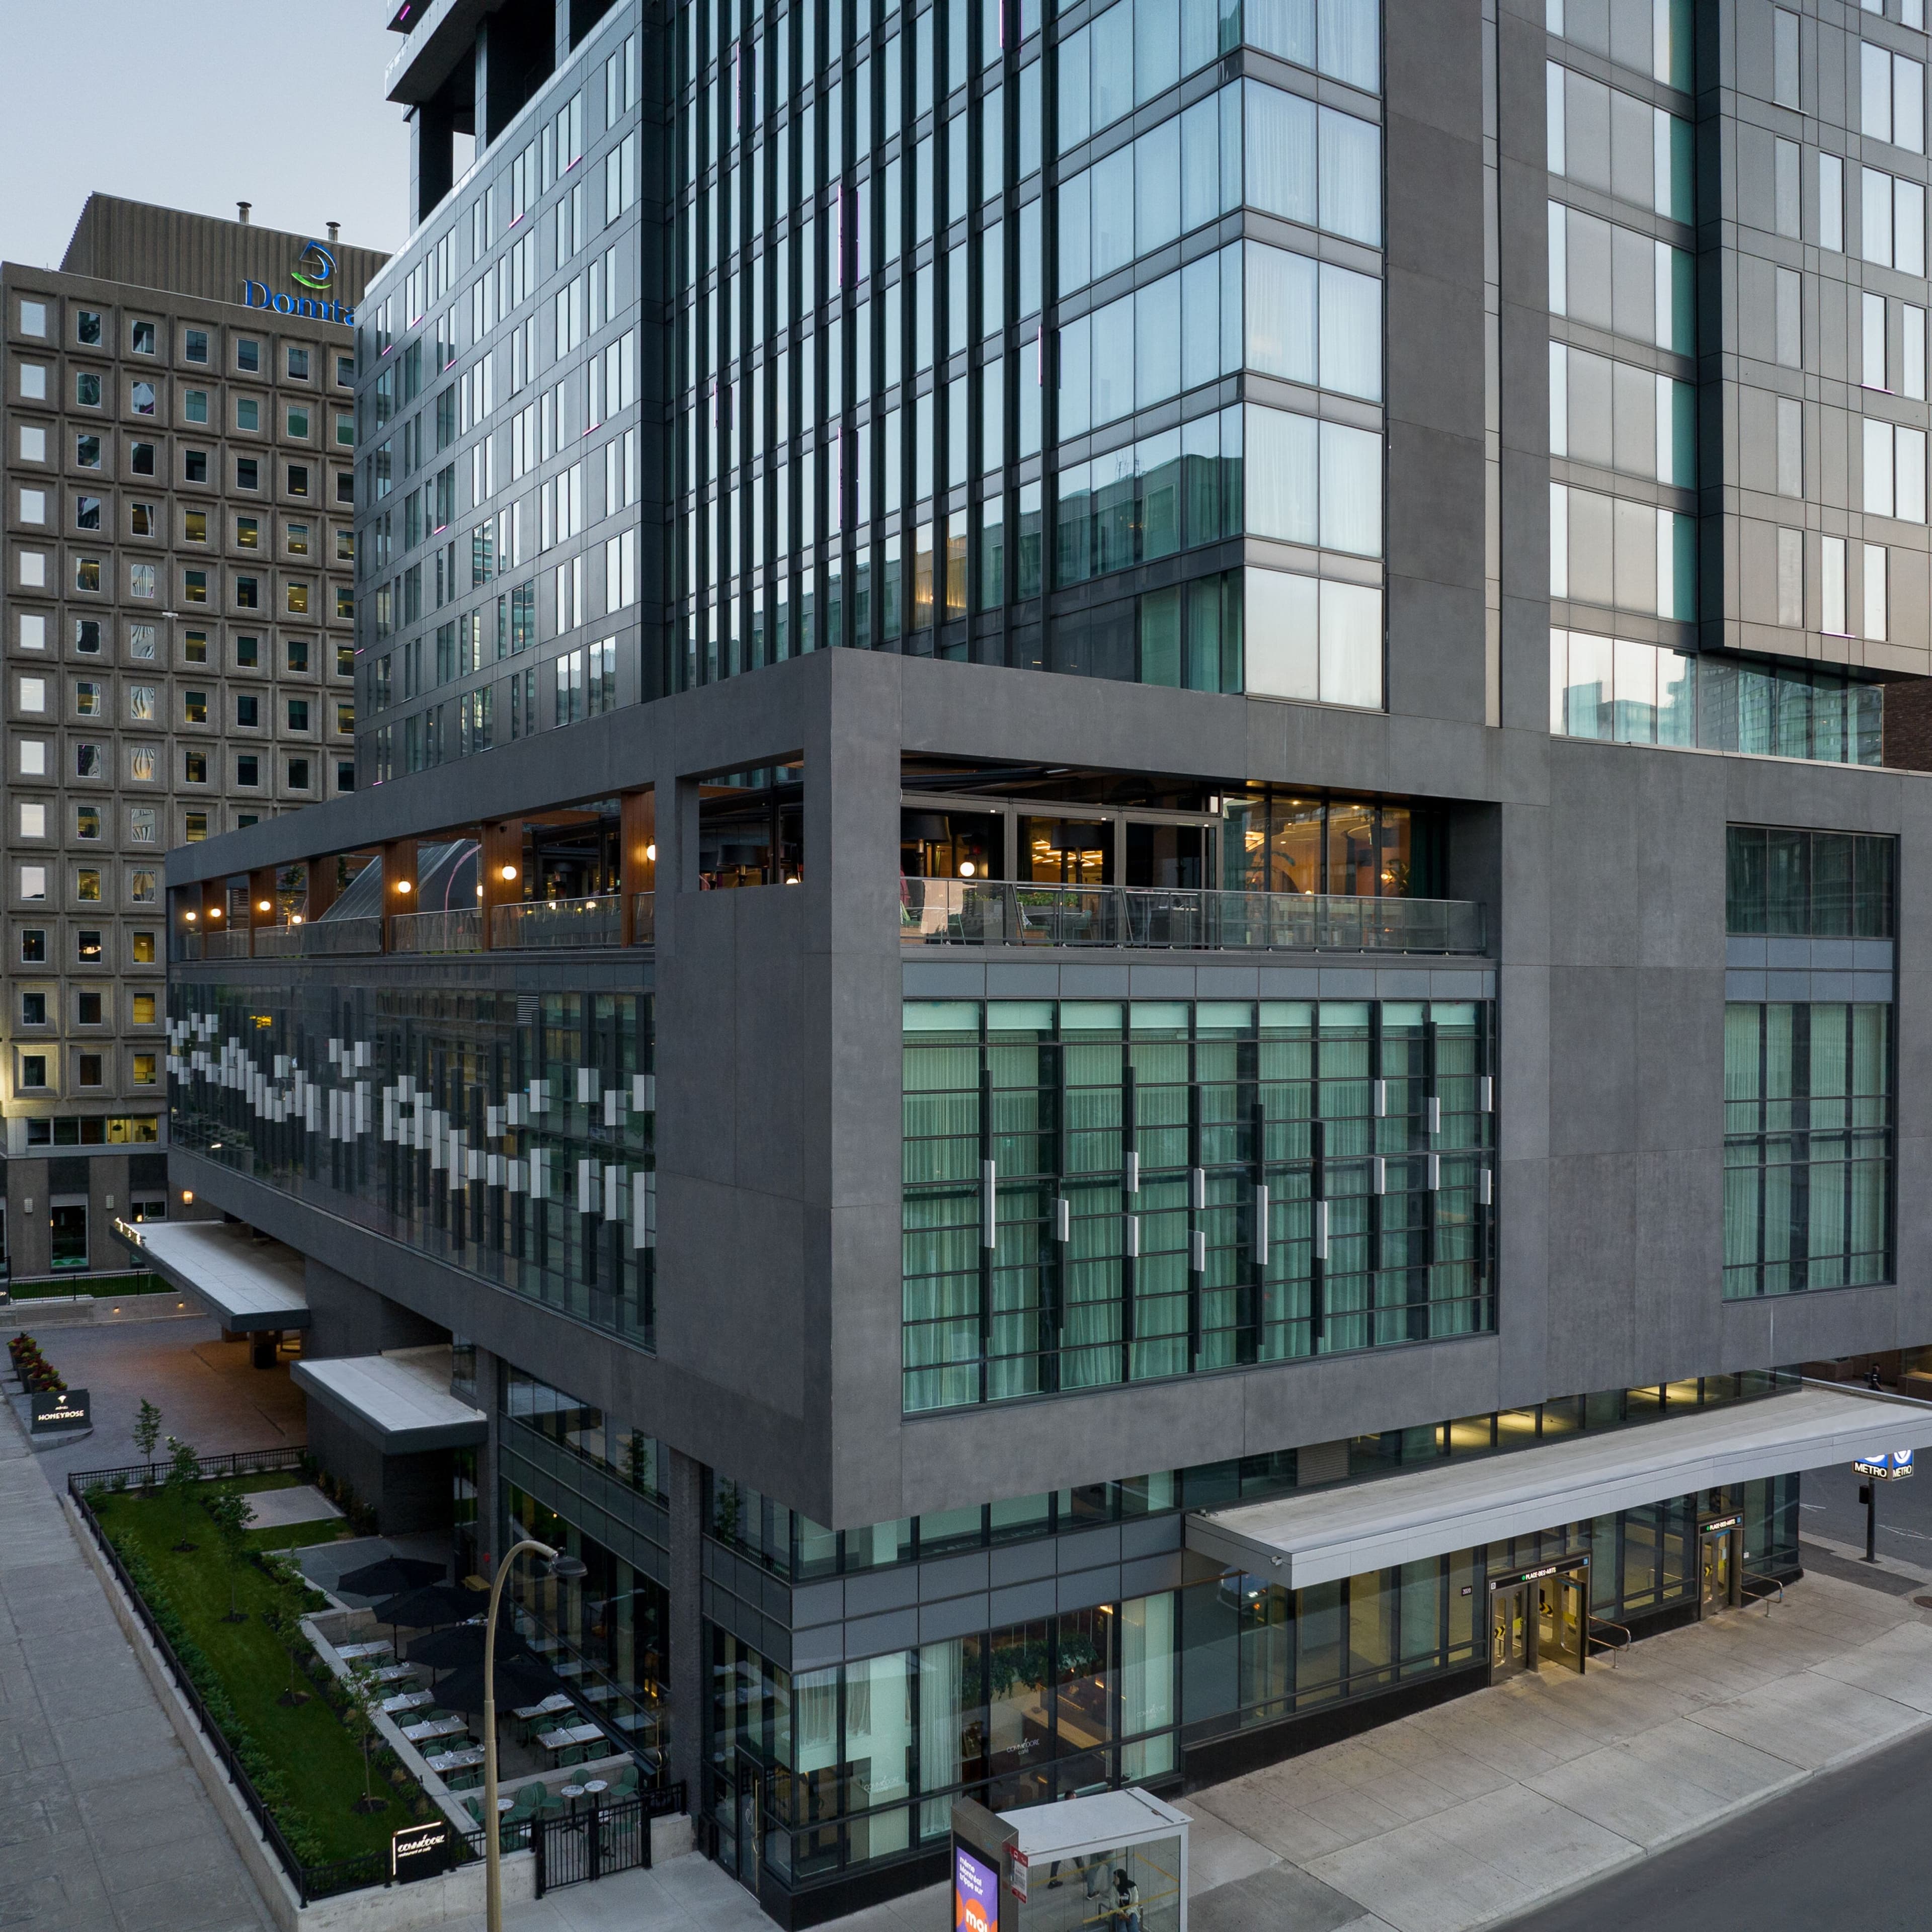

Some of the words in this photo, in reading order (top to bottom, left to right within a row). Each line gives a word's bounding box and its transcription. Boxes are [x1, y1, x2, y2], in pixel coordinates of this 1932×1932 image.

[38, 1410, 84, 1421] HONEYROSE
[959, 1857, 975, 1873] même
[959, 1864, 982, 1886] Montréal
[959, 1872, 974, 1890] trippe
[974, 1885, 984, 1896] sur
